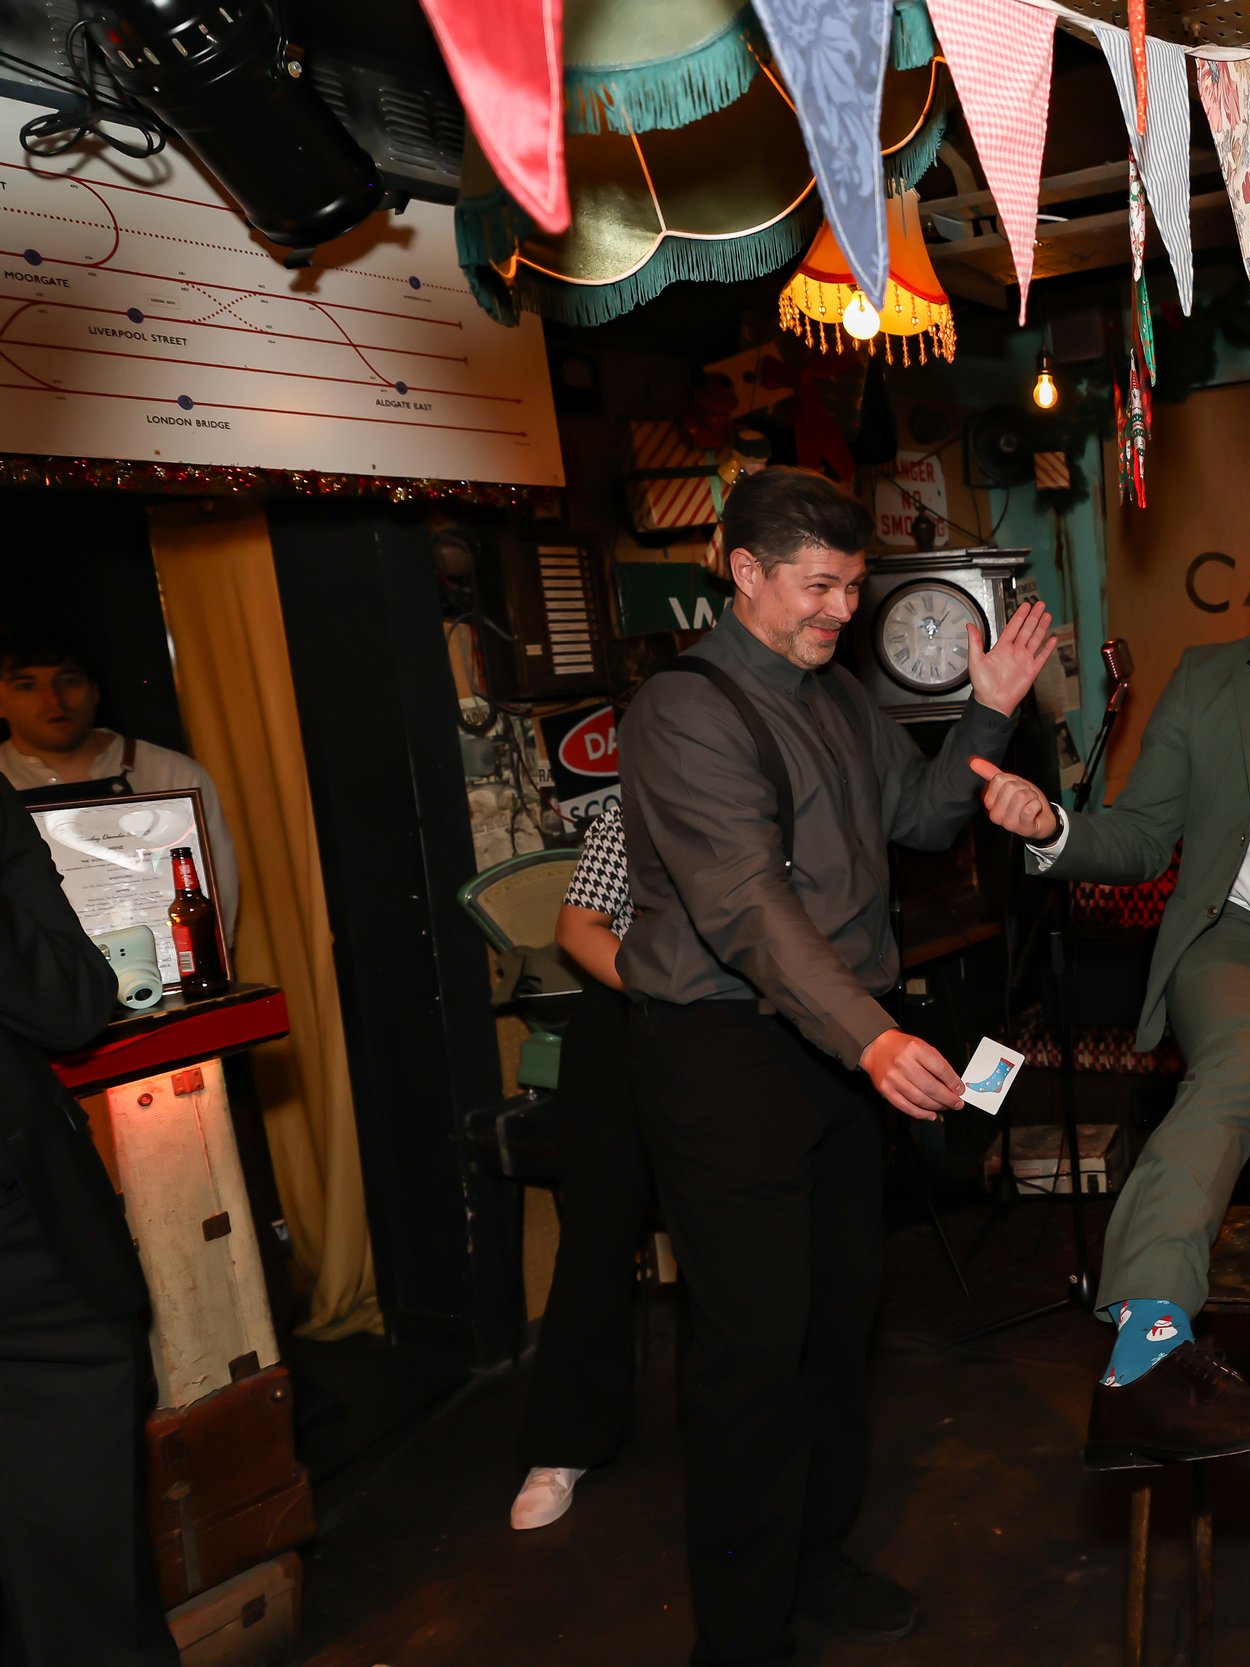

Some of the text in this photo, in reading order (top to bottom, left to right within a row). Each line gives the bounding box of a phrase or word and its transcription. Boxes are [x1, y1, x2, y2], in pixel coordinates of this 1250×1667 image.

[4, 270, 70, 288] MOORGATE
[88, 325, 188, 346] LIVERPOOL STREET
[375, 398, 433, 412] ALDGATE EAST
[146, 414, 232, 430] LONDON BRIDGE
[881, 513, 945, 538] SMOG
